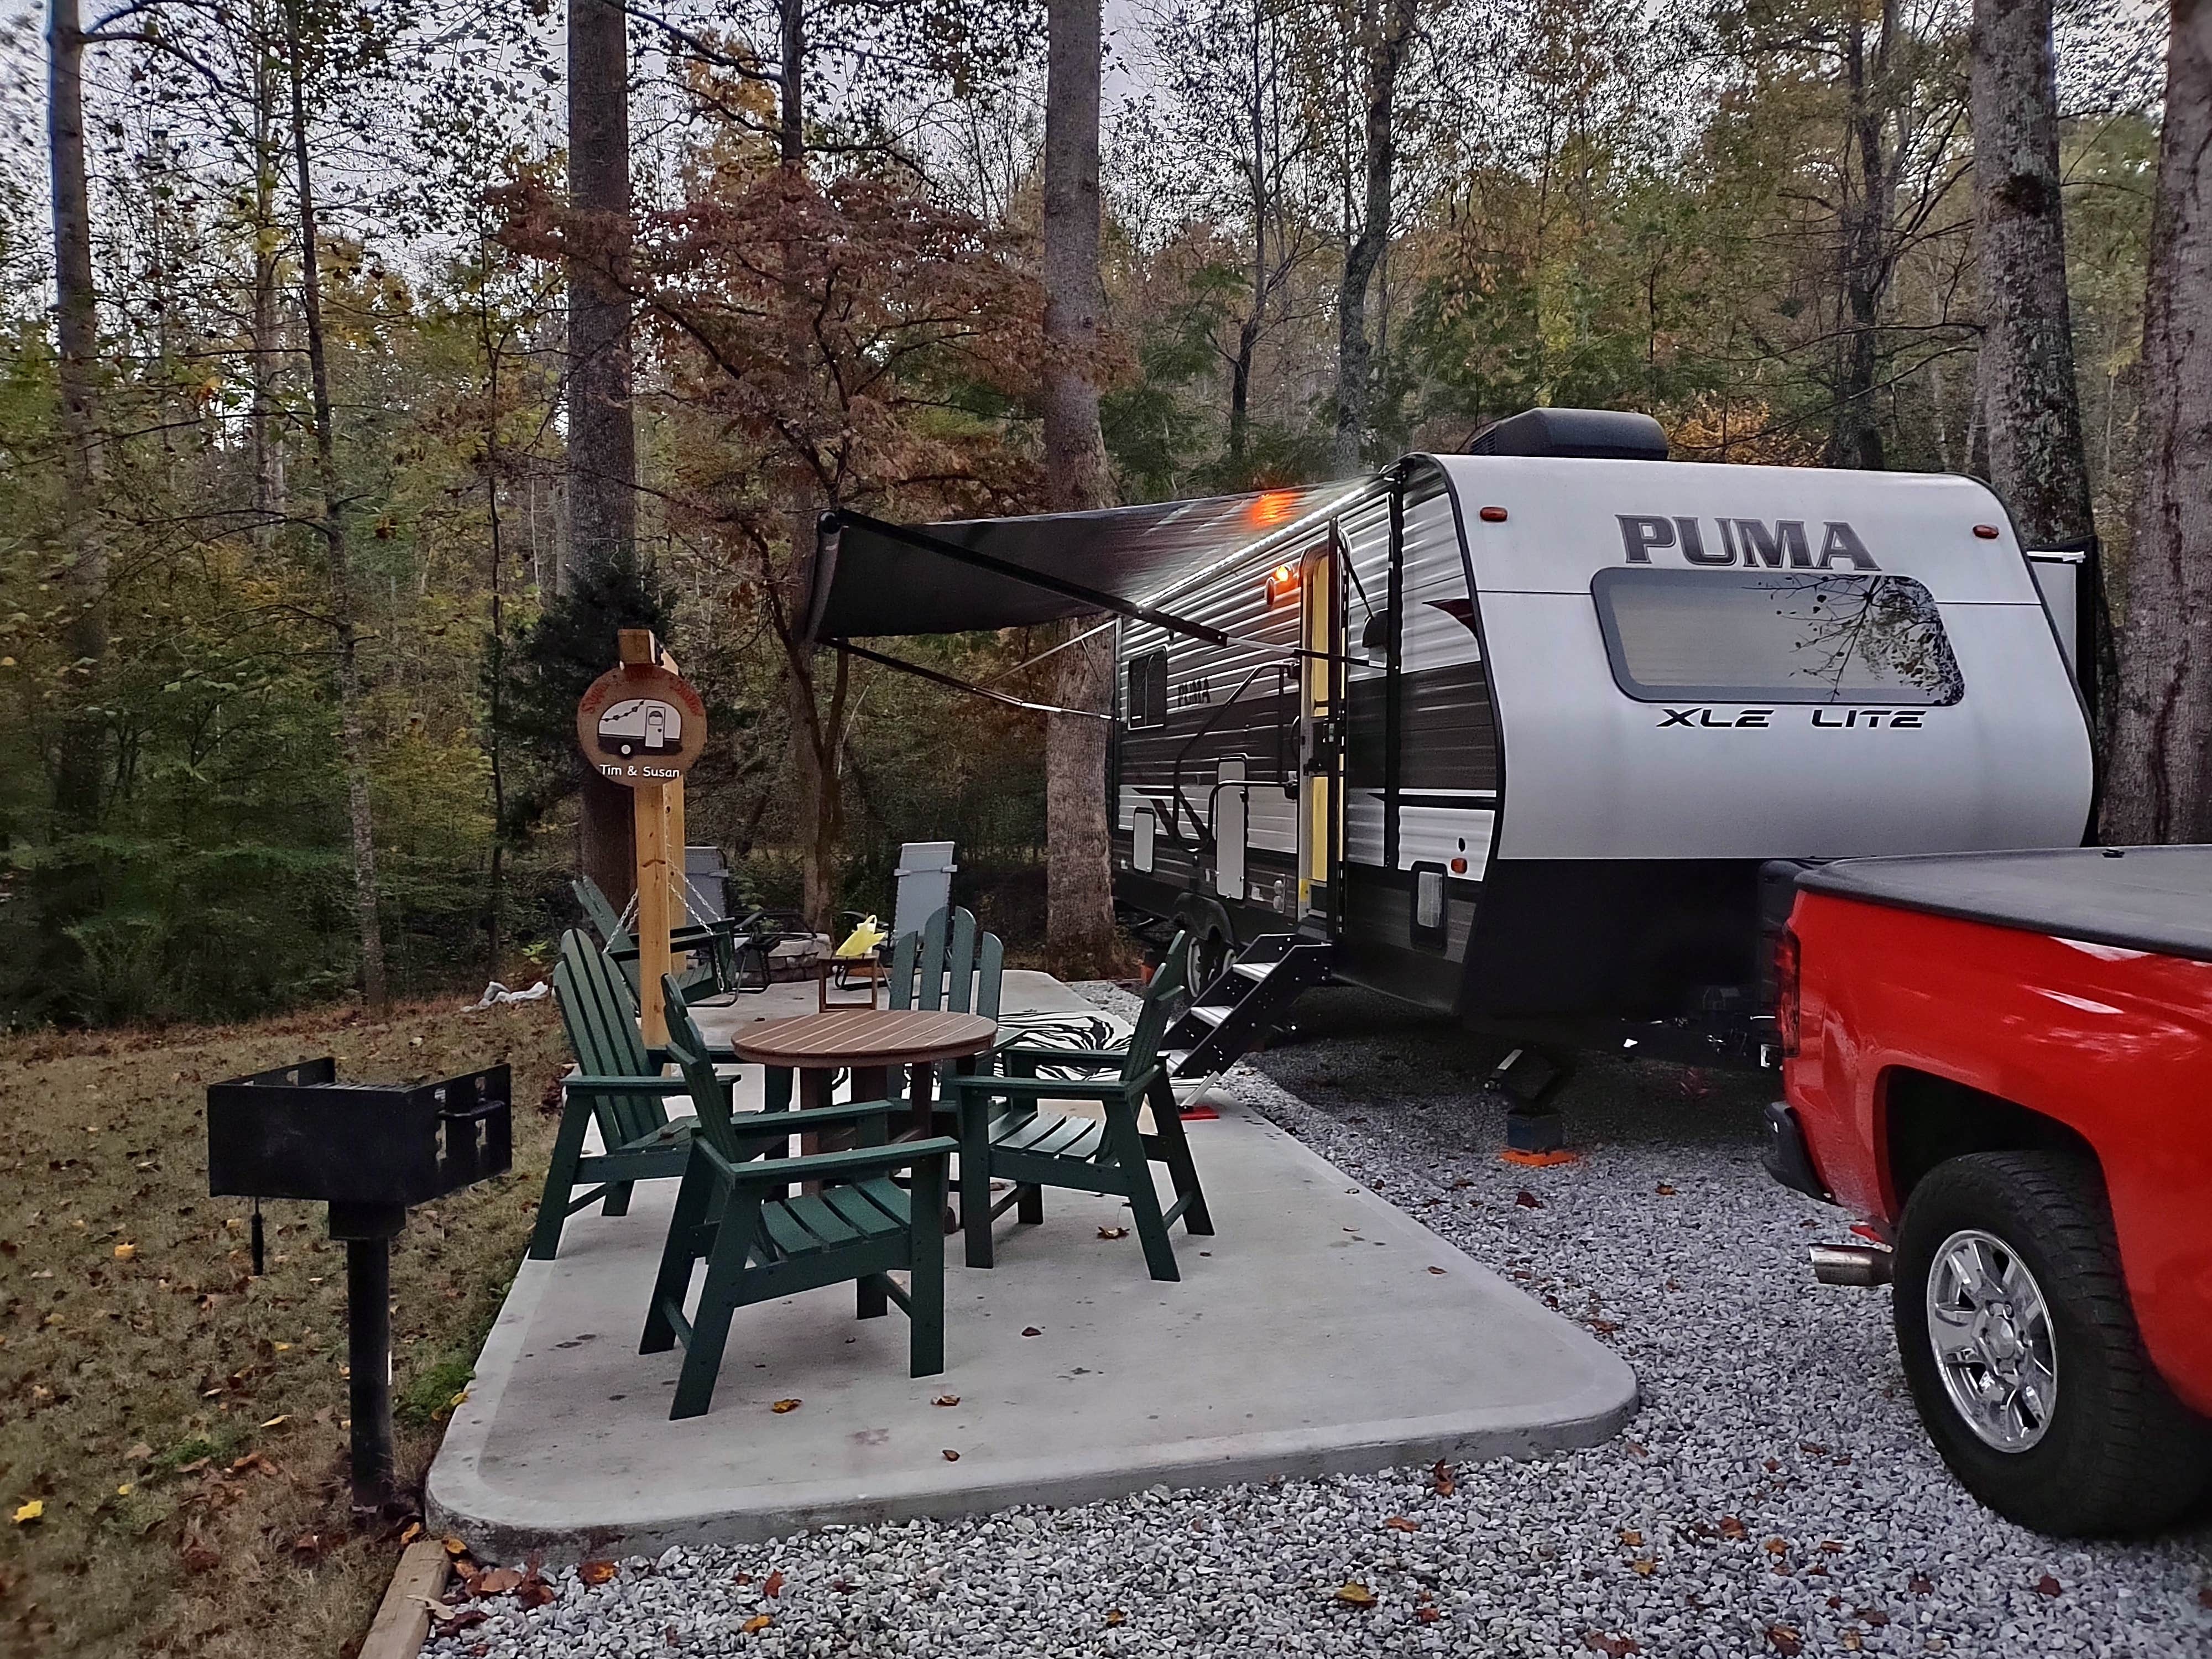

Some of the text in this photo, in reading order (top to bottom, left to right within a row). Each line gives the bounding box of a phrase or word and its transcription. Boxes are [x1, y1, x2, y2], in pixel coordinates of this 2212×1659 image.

[1615, 514, 1882, 572] PUMA
[1177, 678, 1211, 707] PUMA
[1656, 707, 1927, 728] XLE LITE
[599, 764, 680, 778] Tim & Susan
